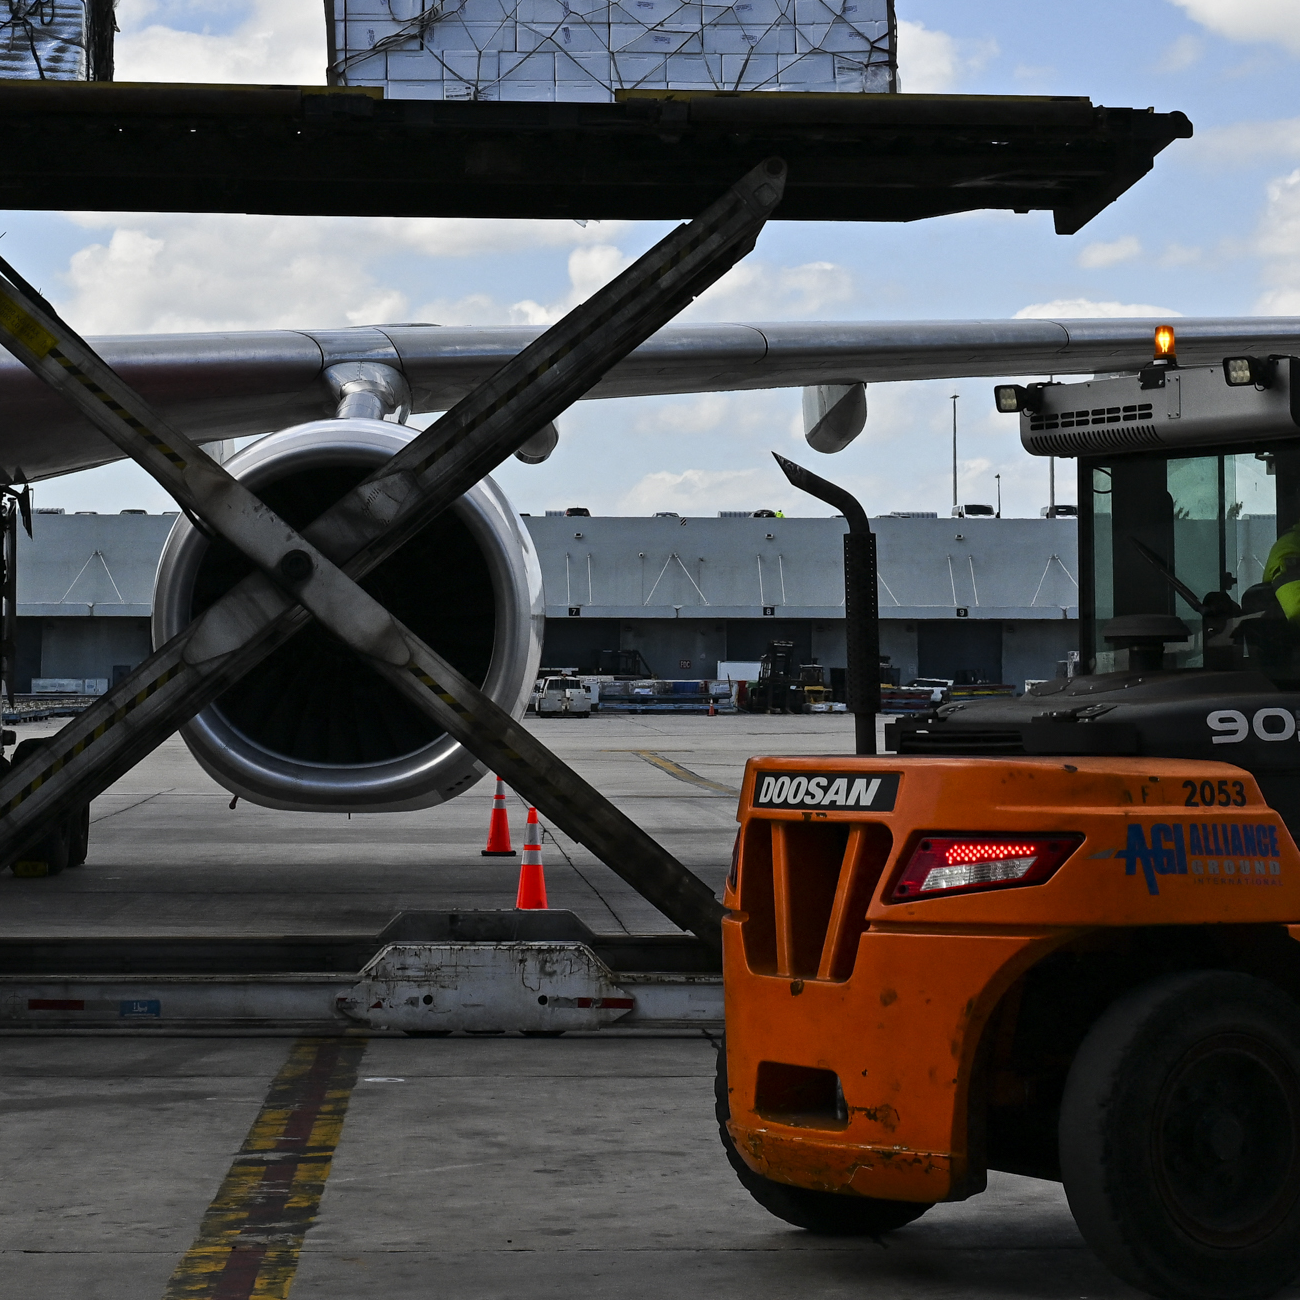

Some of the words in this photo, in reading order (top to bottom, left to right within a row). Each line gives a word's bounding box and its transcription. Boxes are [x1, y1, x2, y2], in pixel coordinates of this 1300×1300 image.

[1206, 707, 1296, 744] 90
[759, 776, 881, 806] DOOSAN
[1182, 780, 1247, 807] 2053
[1189, 822, 1281, 858] ALLIANCE
[1115, 823, 1188, 895] AGI
[1191, 860, 1281, 876] GROUND
[1193, 877, 1284, 887] INTERNATIONAL
